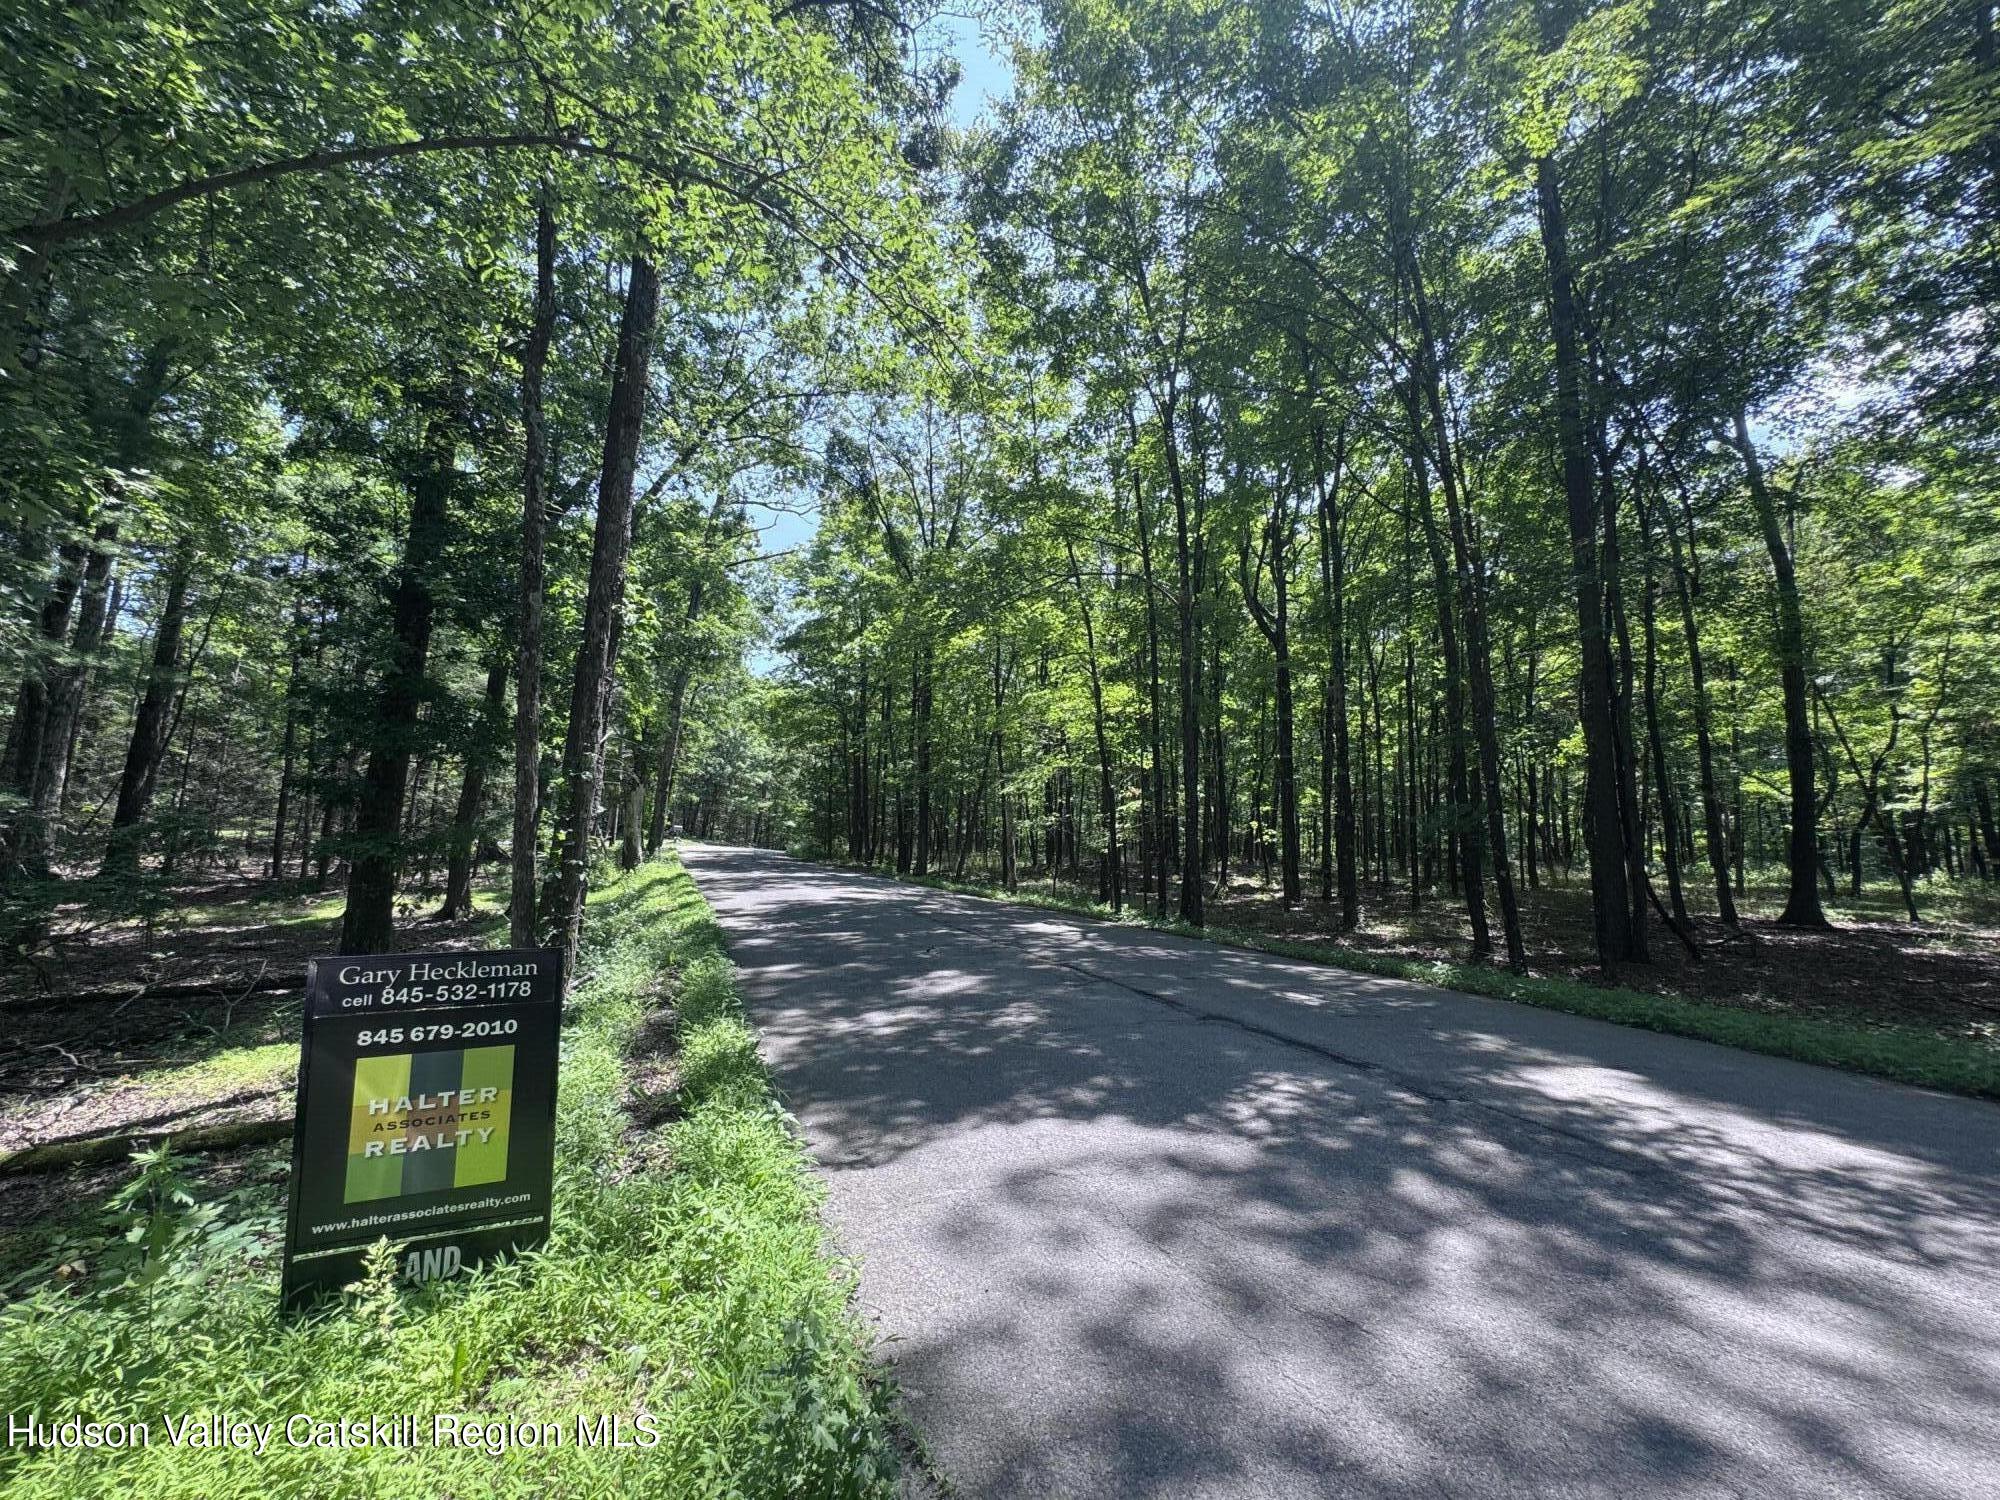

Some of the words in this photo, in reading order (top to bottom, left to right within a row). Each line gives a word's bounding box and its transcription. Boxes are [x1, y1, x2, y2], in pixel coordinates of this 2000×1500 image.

[339, 965, 402, 990] Gary
[409, 960, 538, 983] Heckleman
[342, 994, 372, 1008] cell
[381, 981, 532, 1006] 845-532-1178
[357, 1028, 404, 1047] 845
[410, 1019, 518, 1042] 679-2010
[368, 1087, 498, 1116] HALTER
[374, 1110, 491, 1132] ASSOCIATES
[365, 1128, 494, 1159] REALTY
[312, 1192, 532, 1235] www.halterassociatesrealty.com
[402, 1245, 462, 1284] AND
